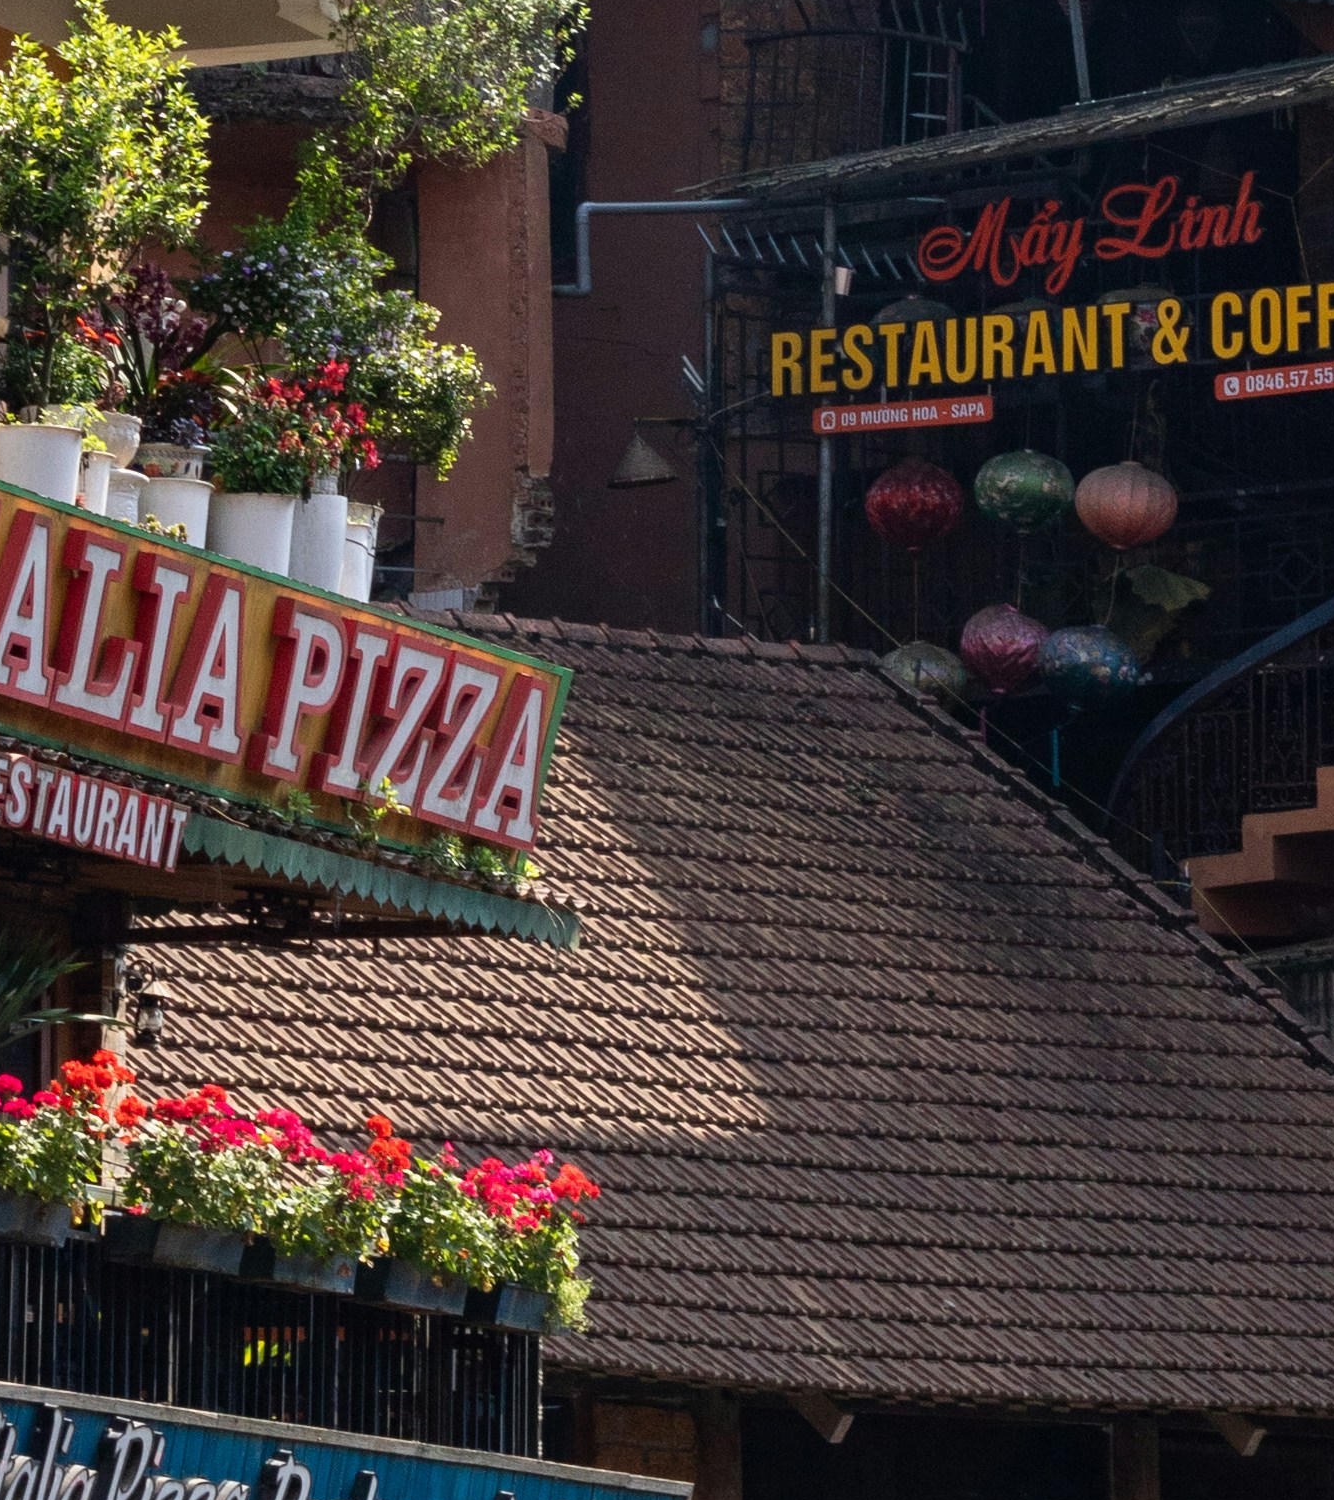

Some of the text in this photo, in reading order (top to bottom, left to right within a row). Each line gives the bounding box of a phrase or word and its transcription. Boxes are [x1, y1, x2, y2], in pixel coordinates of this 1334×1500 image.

[1096, 171, 1264, 259] Linh
[770, 302, 1131, 397] RESTAURANT
[1152, 298, 1190, 366] &
[841, 411, 856, 427] 09
[912, 406, 938, 421] HOA
[951, 403, 985, 418] SAPA
[251, 597, 547, 852] PIZZA
